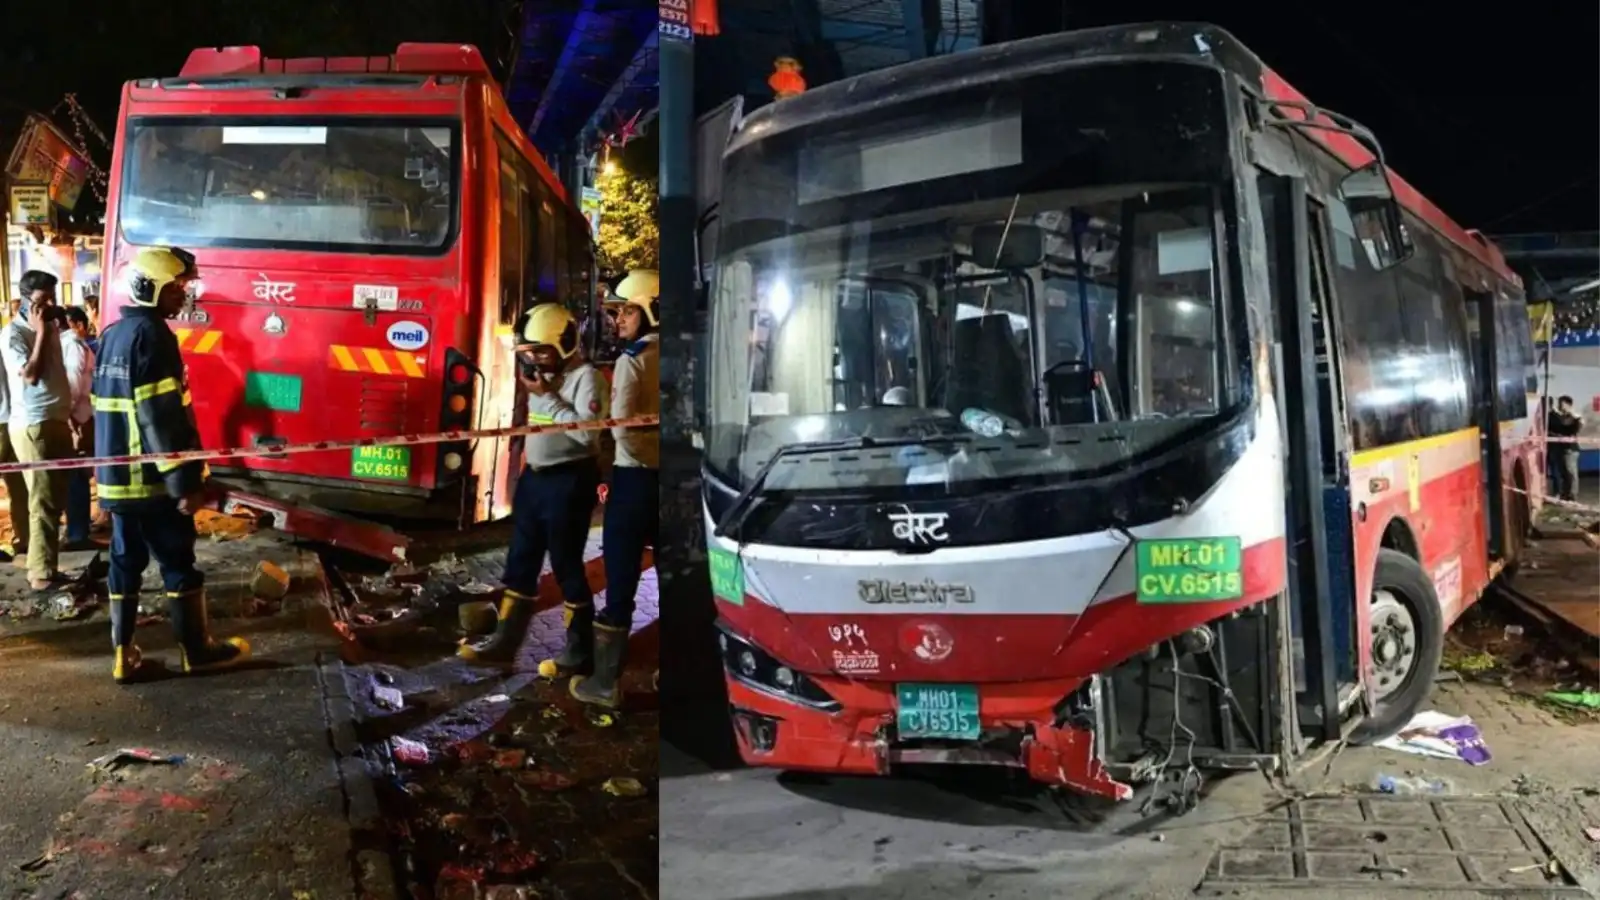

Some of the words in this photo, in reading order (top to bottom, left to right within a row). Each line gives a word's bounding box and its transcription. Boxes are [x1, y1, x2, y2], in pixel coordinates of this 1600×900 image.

[251, 272, 297, 303] बेस्ट
[391, 330, 423, 342] meil
[360, 446, 402, 460] MH.01
[353, 461, 408, 478] CV.6515
[887, 503, 950, 545] बेस्ट
[1150, 543, 1226, 568] MH.01
[1141, 571, 1241, 596] CV.6515
[918, 689, 957, 708] MH01
[908, 708, 970, 732] CV6515
